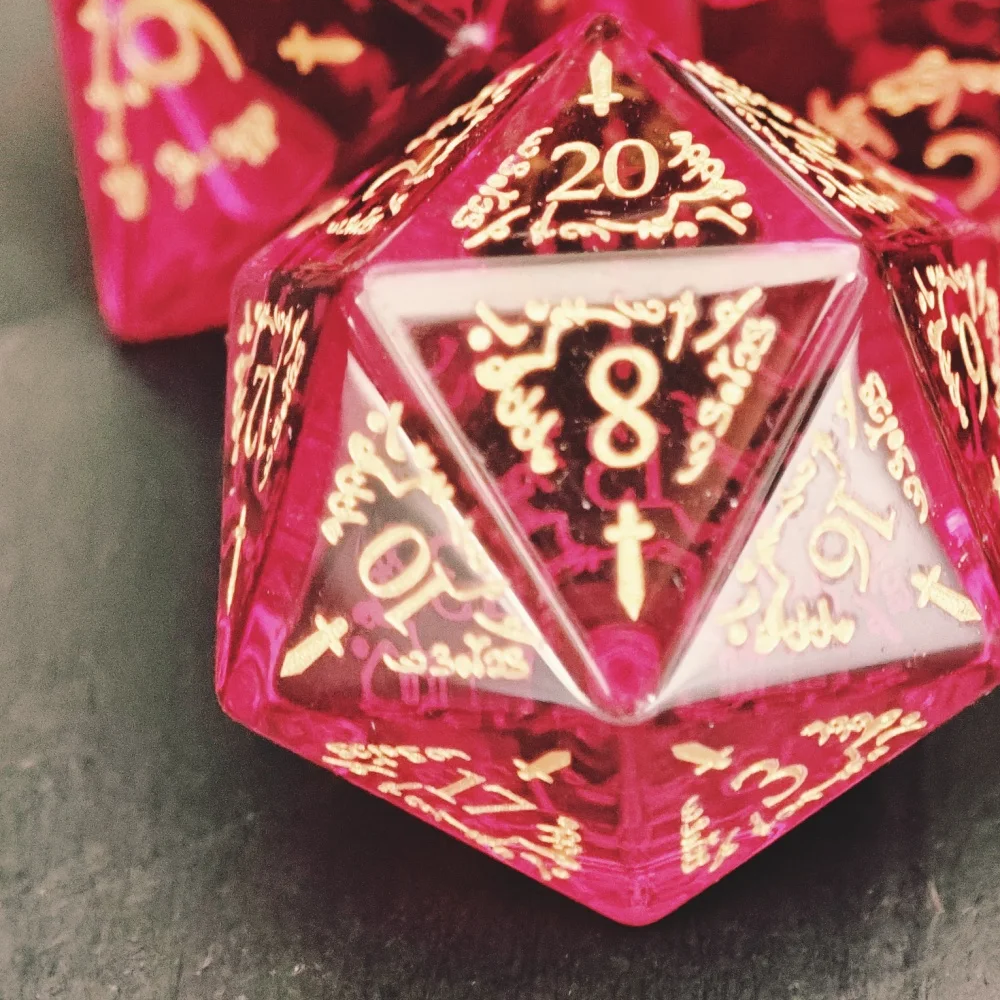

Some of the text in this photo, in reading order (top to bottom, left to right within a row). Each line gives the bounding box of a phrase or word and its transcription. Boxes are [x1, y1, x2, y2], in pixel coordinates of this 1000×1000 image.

[546, 139, 660, 205] 20
[586, 344, 660, 468] 8
[809, 477, 896, 593] 16
[358, 524, 450, 637] 10
[424, 767, 537, 815] 17
[731, 758, 808, 808] 3
